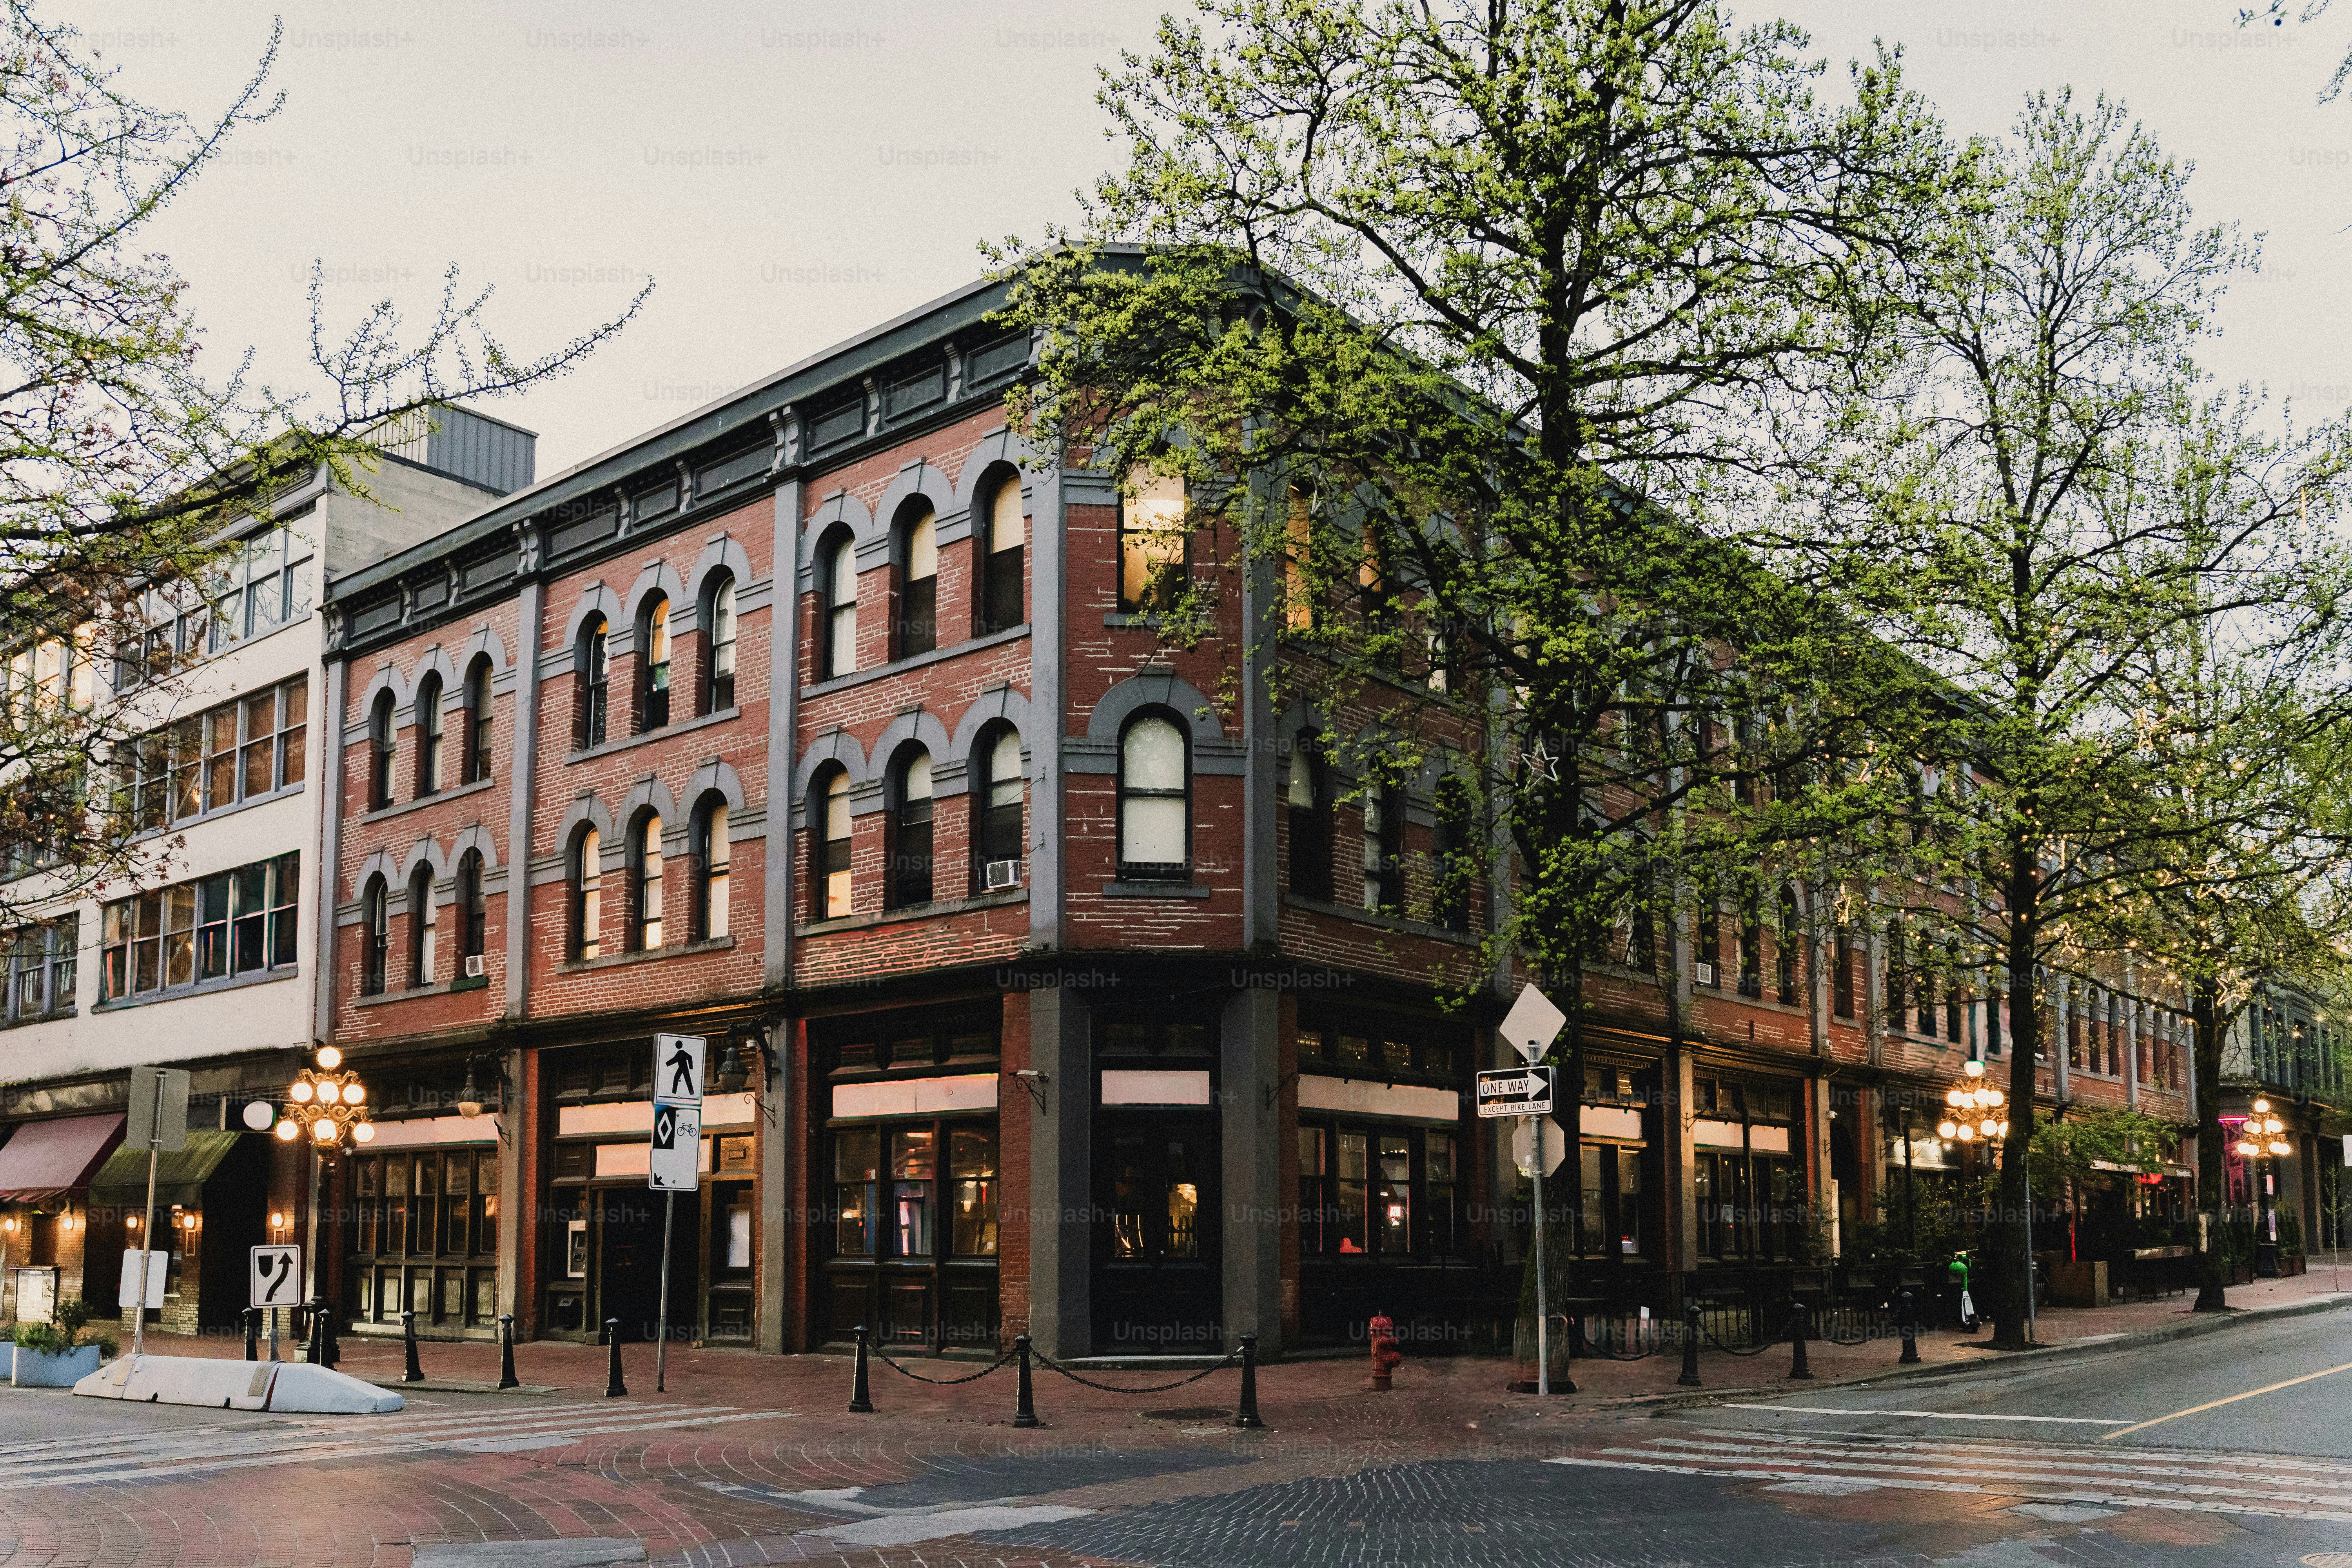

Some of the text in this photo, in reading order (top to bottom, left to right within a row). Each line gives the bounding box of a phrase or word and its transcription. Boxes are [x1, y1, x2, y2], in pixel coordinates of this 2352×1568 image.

[1483, 1080, 1529, 1094] ONE WAY
[1484, 1105, 1507, 1113] EXCEPT
